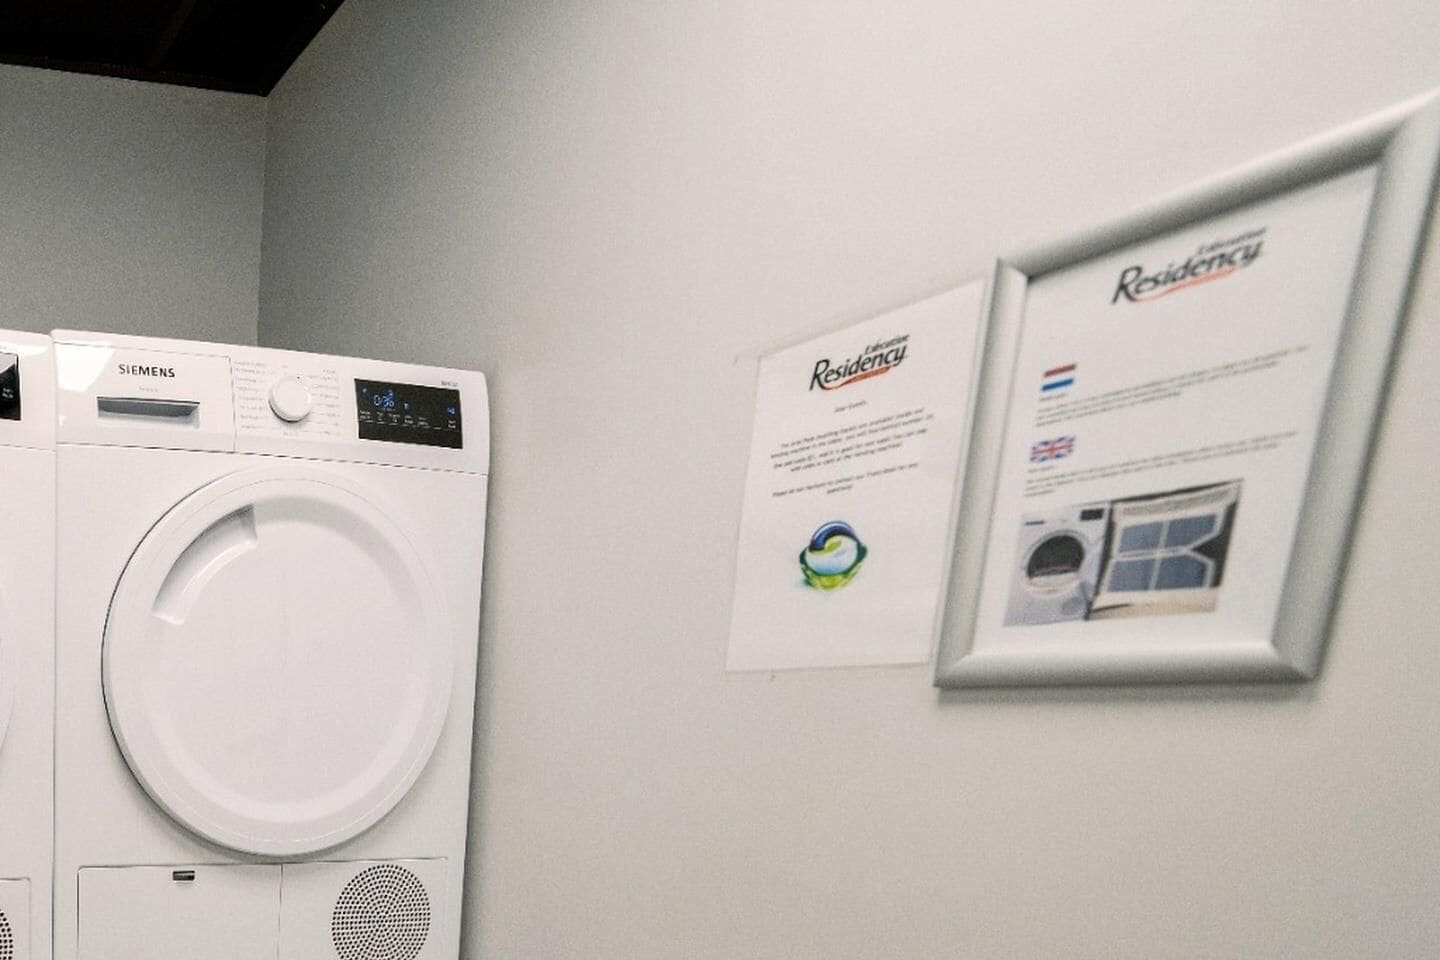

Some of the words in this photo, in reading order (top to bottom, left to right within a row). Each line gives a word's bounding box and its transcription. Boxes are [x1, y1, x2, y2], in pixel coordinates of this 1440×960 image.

[1111, 241, 1265, 303] Residency
[117, 363, 176, 378] SIEMENS
[808, 344, 907, 391] Residency
